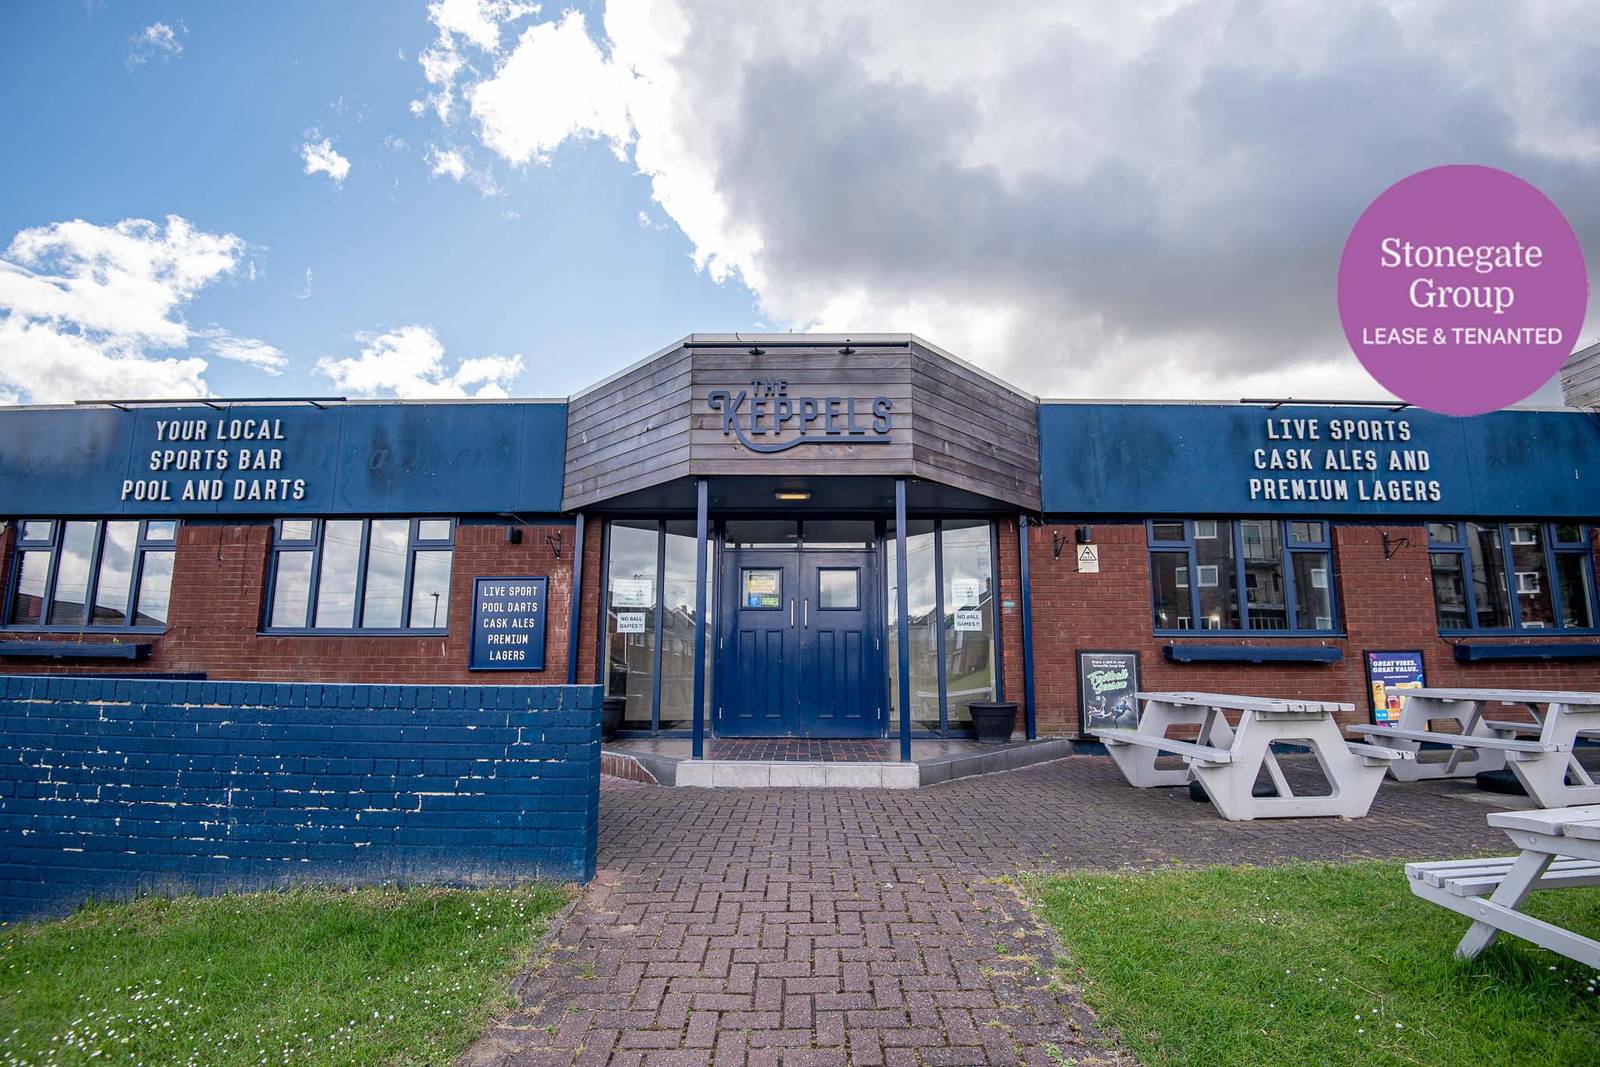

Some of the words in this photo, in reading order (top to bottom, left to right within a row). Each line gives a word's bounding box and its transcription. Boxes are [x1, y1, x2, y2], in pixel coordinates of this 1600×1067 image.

[751, 381, 788, 397] THE
[156, 420, 208, 441] YOUR
[216, 419, 285, 440] LOCAL
[707, 390, 893, 454] KEPPELS
[1267, 418, 1320, 440] LIVE
[1330, 419, 1411, 441] SPORTS
[150, 449, 229, 471] SPORTS
[238, 449, 282, 470] BAR
[1253, 448, 1313, 470] CASK
[1325, 449, 1377, 471] ALES
[1389, 450, 1430, 471] AND
[121, 479, 171, 501] POOL
[181, 479, 224, 500] AND
[233, 479, 306, 500] DARTS
[1250, 478, 1349, 500] PREMIUM
[1358, 480, 1441, 502] LAGERS
[483, 586, 506, 597] LIVE
[508, 586, 538, 597] SPORT
[482, 602, 504, 613] POOL
[507, 602, 538, 612] DARTS
[483, 618, 508, 628] CASK
[511, 618, 535, 628] ALES
[487, 634, 529, 645] PREMIUM
[489, 650, 525, 661] LAGERS
